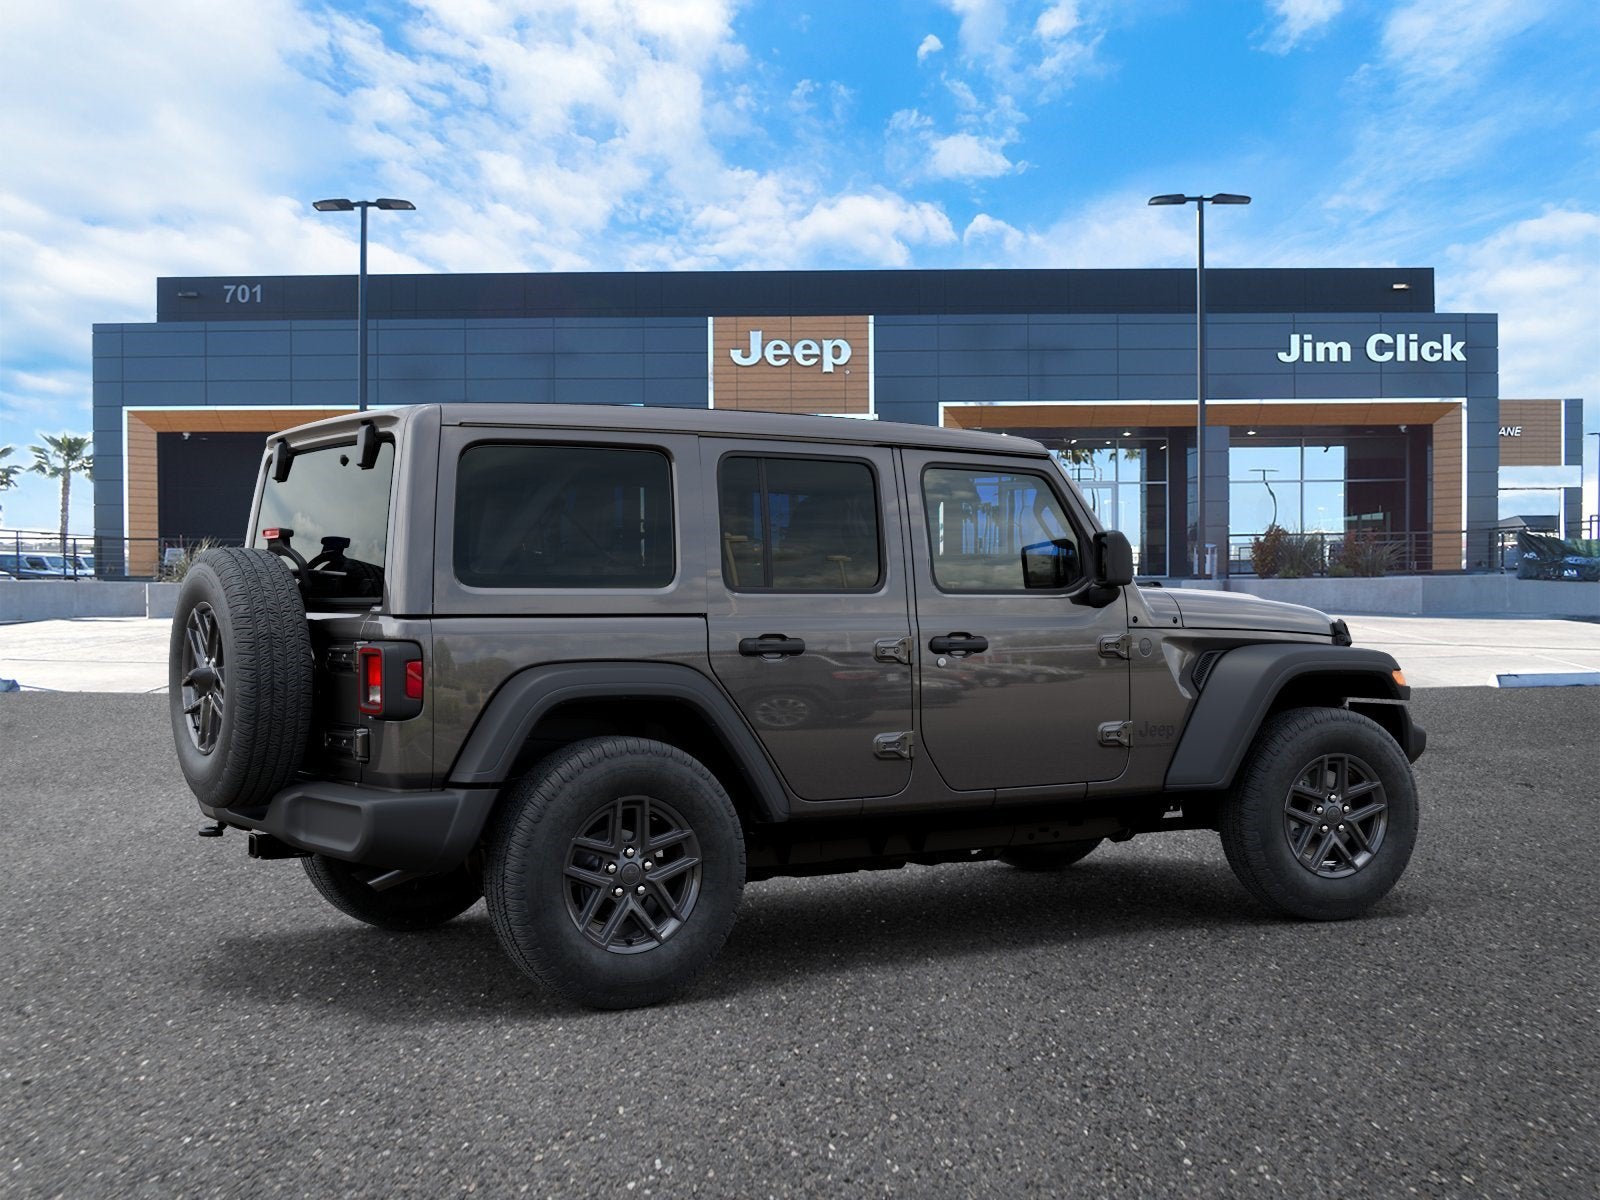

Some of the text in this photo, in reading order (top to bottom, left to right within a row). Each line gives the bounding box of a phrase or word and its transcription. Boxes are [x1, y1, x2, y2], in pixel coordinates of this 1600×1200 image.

[223, 284, 262, 303] 701
[729, 329, 852, 373] Jeep
[1277, 333, 1467, 362] Jim Click
[1138, 720, 1174, 740] Jeep
